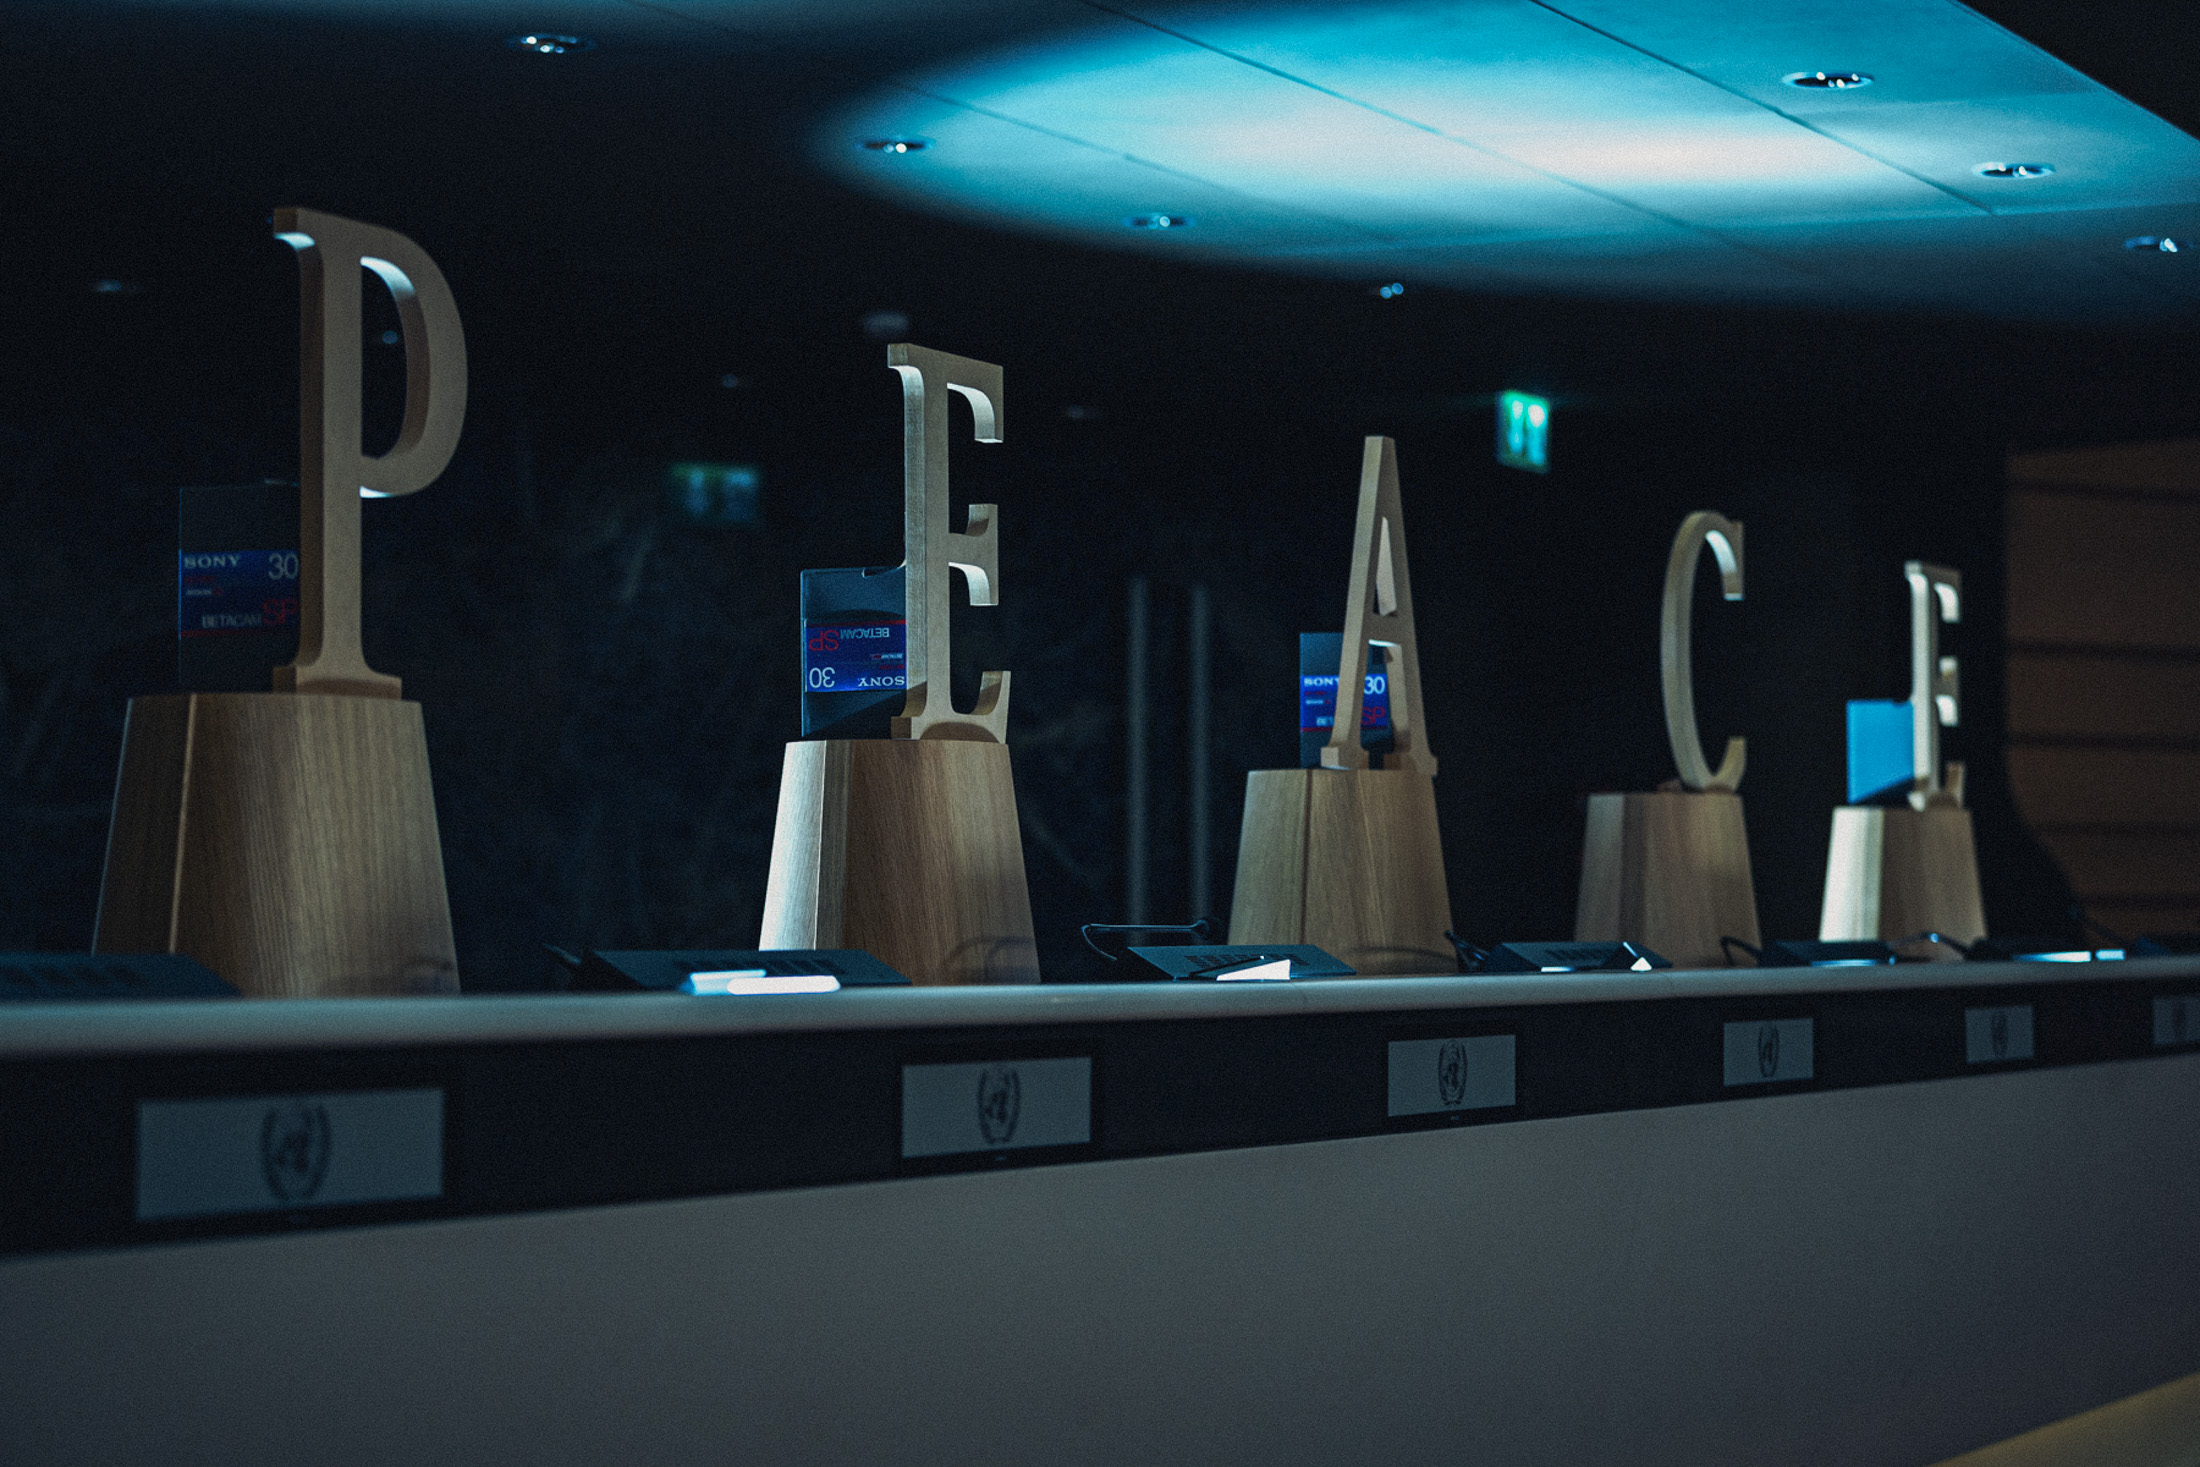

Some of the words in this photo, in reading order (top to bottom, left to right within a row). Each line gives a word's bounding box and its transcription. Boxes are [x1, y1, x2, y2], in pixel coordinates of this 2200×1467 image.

[184, 554, 241, 569] SONY
[268, 552, 299, 580] 30
[808, 629, 840, 651] SP
[840, 627, 890, 638] BETACAM
[809, 666, 835, 689] 30
[857, 675, 905, 687] SONY
[1364, 675, 1385, 695] 30
